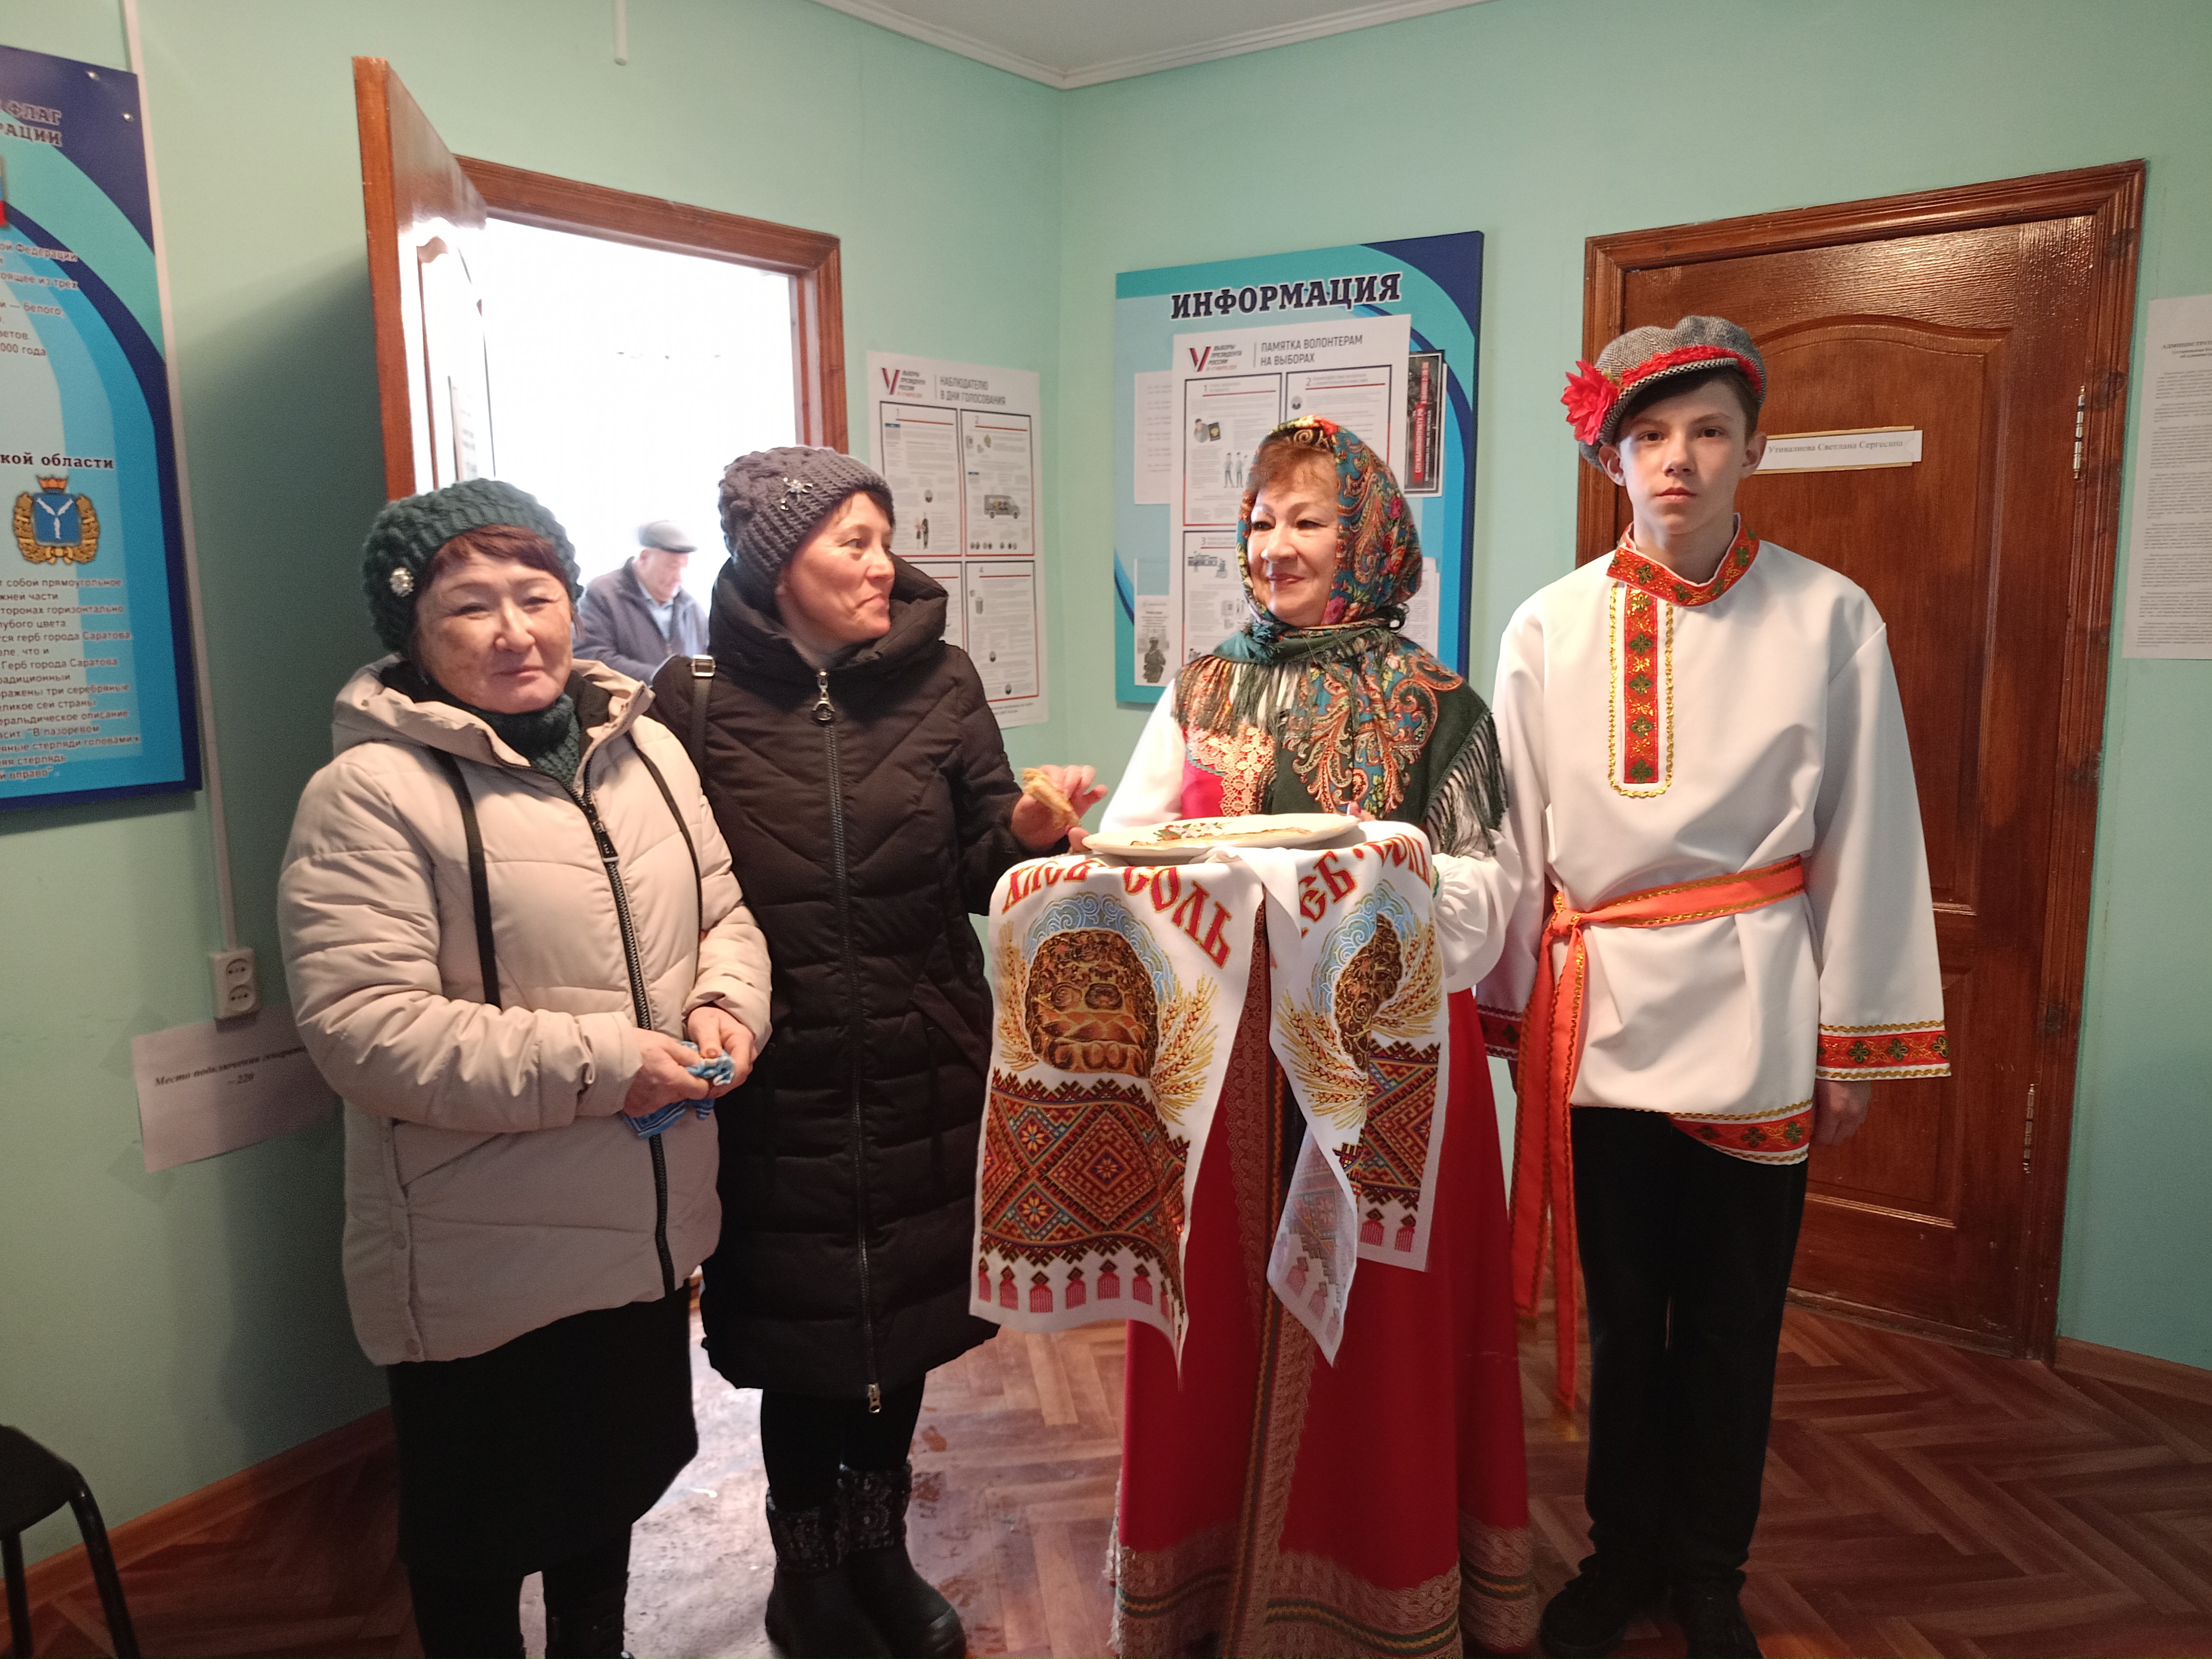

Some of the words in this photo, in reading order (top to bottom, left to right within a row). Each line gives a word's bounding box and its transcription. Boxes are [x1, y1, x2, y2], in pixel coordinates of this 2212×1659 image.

[8, 101, 61, 124] ФЛАГ
[1171, 273, 1401, 319] ИНФОРМАЦИЯ
[1261, 338, 1301, 352] ПАМЯТКА
[1304, 334, 1363, 349] ВОЛОНТЕРАМ
[22, 346, 46, 356] года
[1260, 356, 1272, 366] НА
[1274, 353, 1315, 365] ВЫБОРАХ
[1306, 377, 1312, 387] 2
[1817, 443, 1857, 451] Светлана
[0, 452, 33, 465] кой
[41, 453, 114, 469] области
[47, 605, 124, 616] горизонтально
[17, 632, 41, 643] герб
[44, 633, 80, 642] города
[1, 660, 27, 671] Герб
[30, 660, 66, 670] города
[69, 658, 118, 668] Саратова
[0, 689, 44, 699] ражены
[46, 687, 64, 696] три
[67, 684, 129, 695] серебряные
[81, 710, 128, 720] описание
[0, 744, 29, 752] яные
[33, 741, 80, 751] стерляди
[18, 754, 66, 765] стерлядь
[155, 1073, 190, 1086] Место
